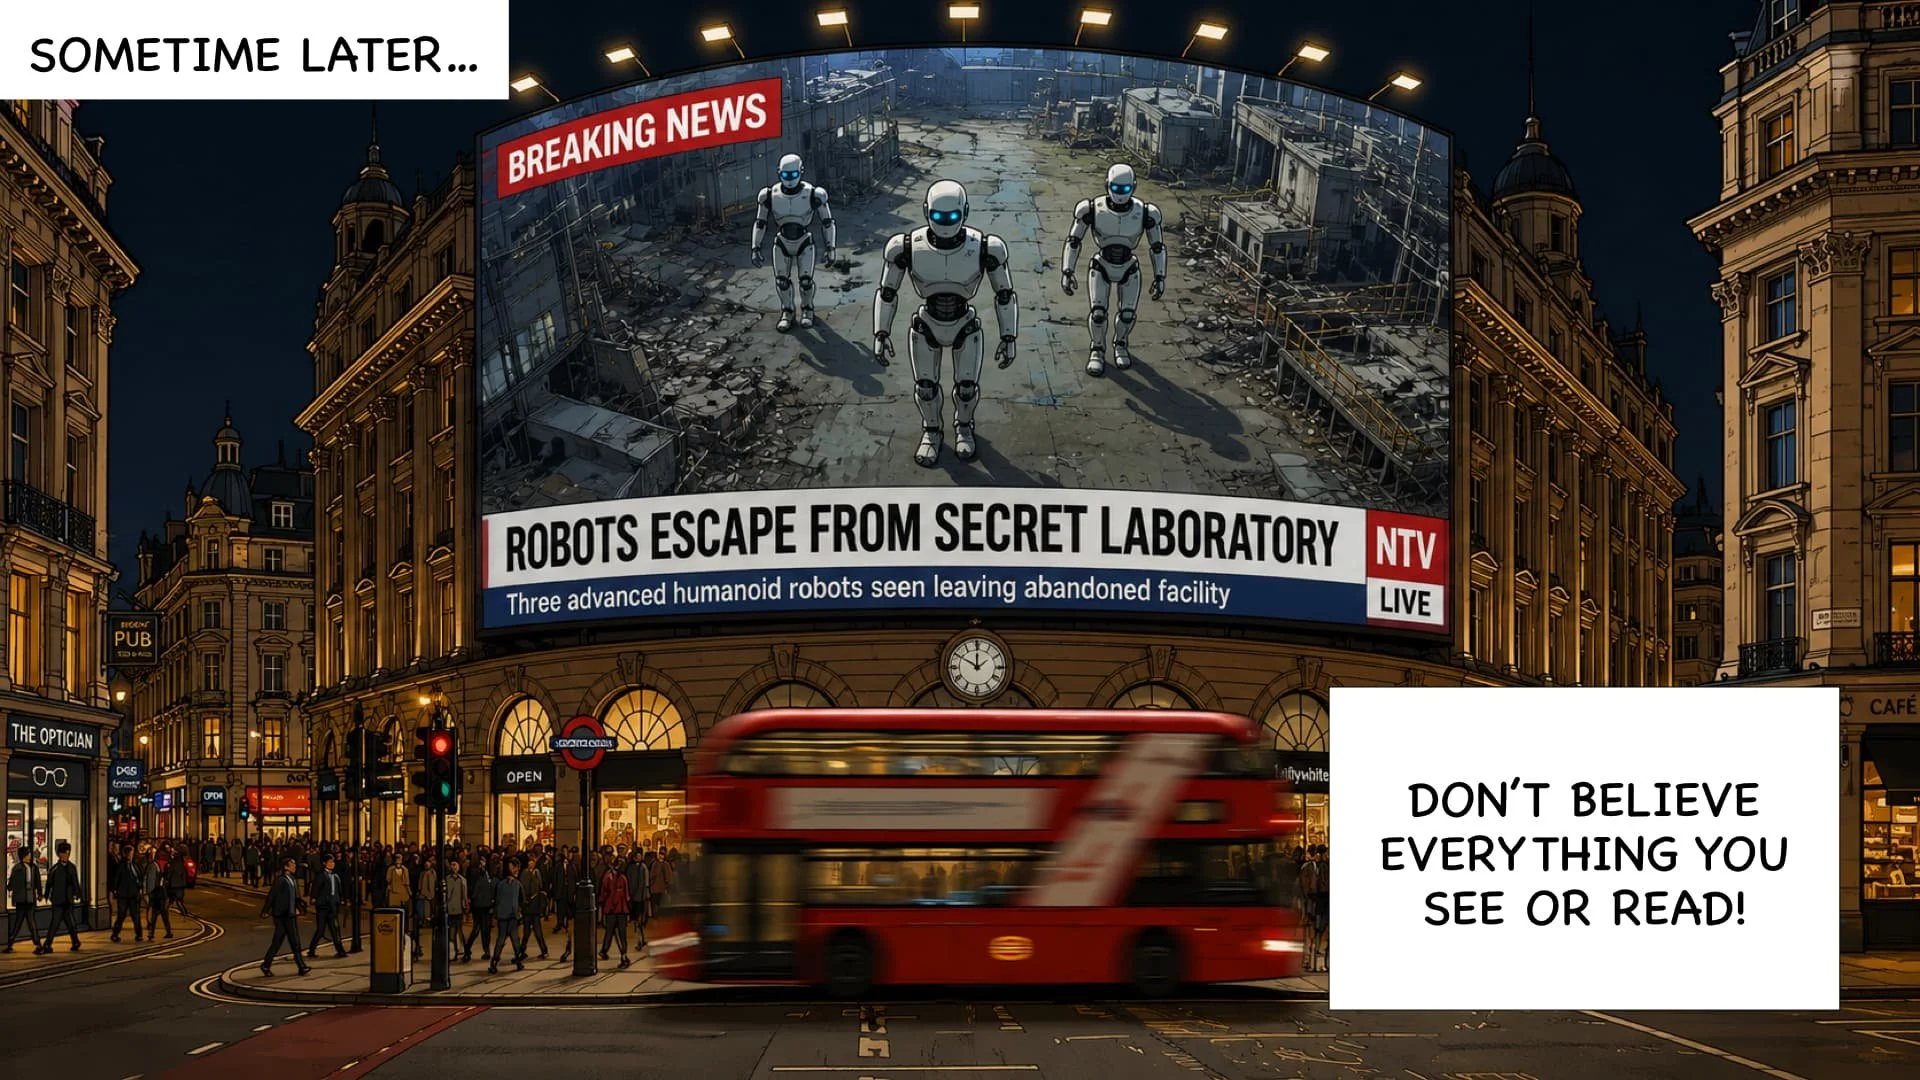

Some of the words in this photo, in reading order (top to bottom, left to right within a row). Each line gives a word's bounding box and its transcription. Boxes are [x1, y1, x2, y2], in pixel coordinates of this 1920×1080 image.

[507, 112, 656, 185] BREAKING
[666, 93, 767, 143] NEWS
[506, 513, 639, 572] ROBOTS
[651, 505, 797, 560] ESCAPE
[810, 503, 921, 553] FROM
[934, 502, 1088, 553] SECRET
[1100, 505, 1339, 567] LABORATORY
[1376, 525, 1437, 570] NTV
[506, 591, 561, 616] Three
[566, 585, 666, 611] advanced
[673, 576, 783, 604] humanoid
[789, 574, 863, 600] robots
[871, 576, 925, 598] seen
[933, 573, 1017, 604] leaving
[1024, 574, 1151, 602] abandoned
[1158, 578, 1231, 610] facility
[1380, 588, 1431, 617] LIVE
[114, 630, 152, 648] PUB
[1870, 694, 1917, 716] CAFÉ
[11, 723, 37, 744] THE
[39, 727, 93, 749] OPTICIAN
[506, 770, 543, 784] OPEN
